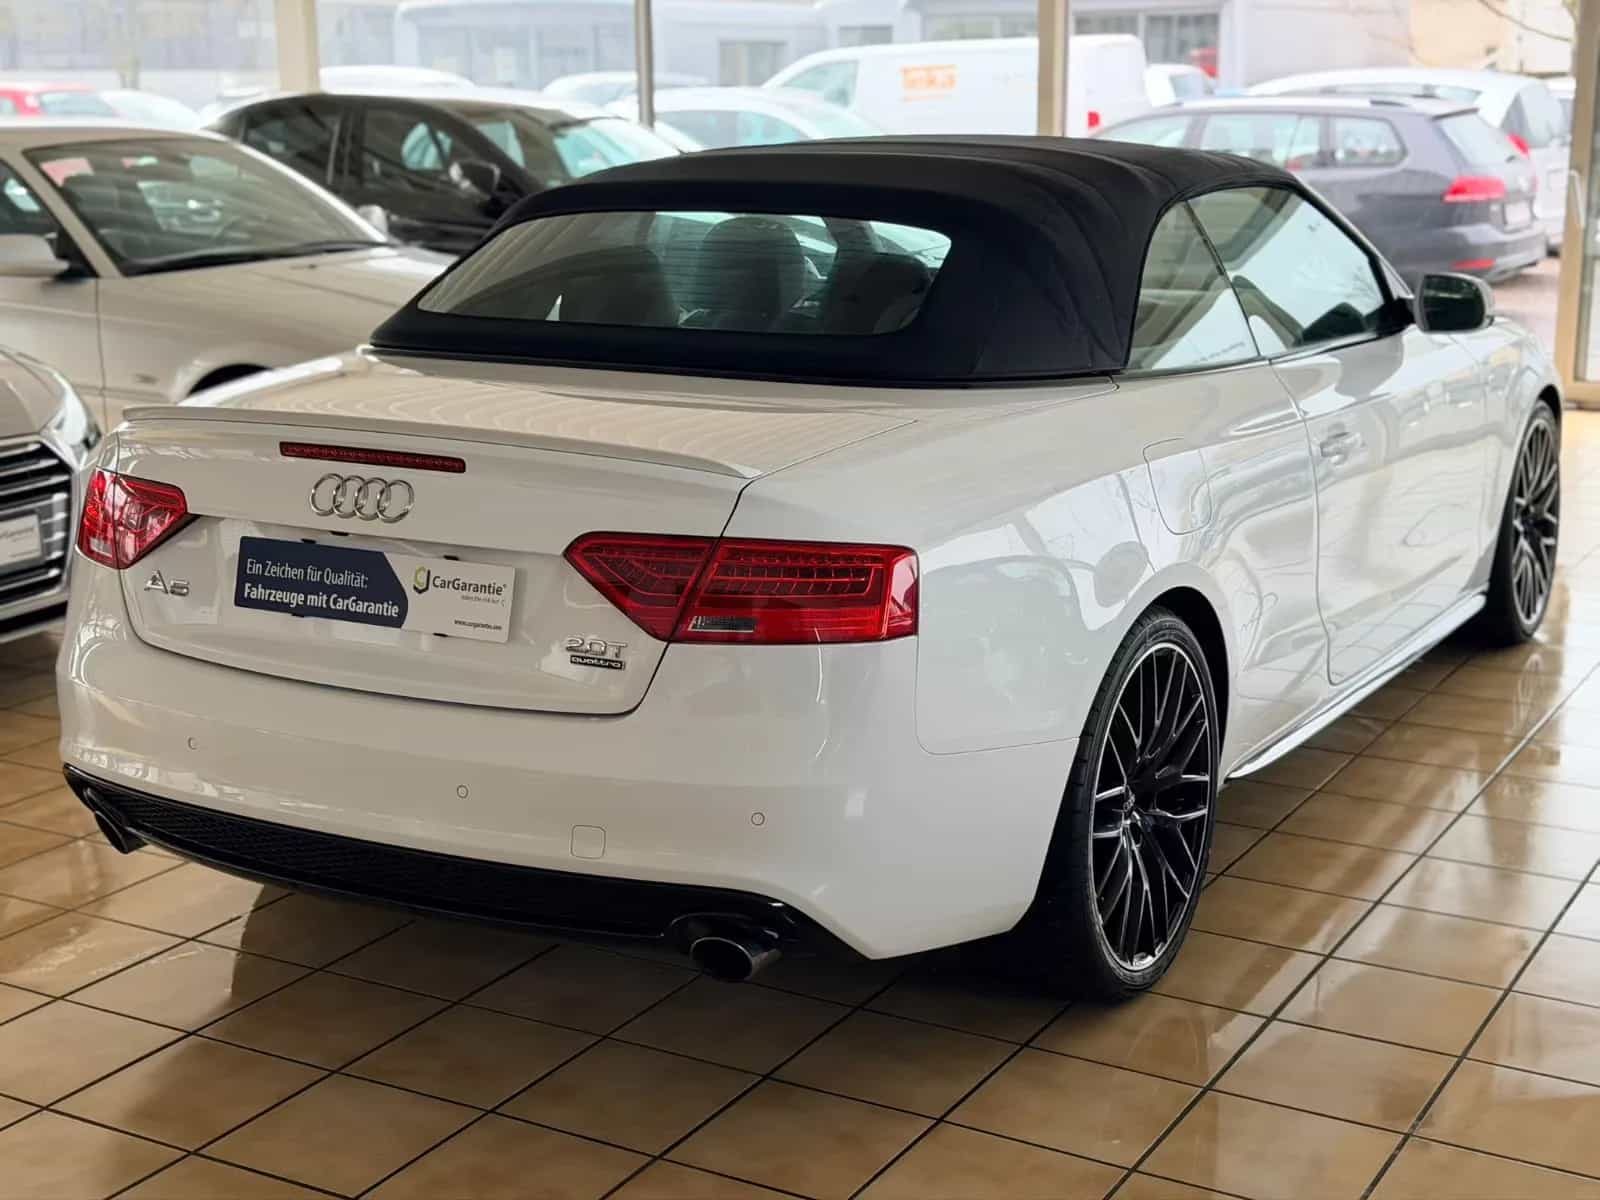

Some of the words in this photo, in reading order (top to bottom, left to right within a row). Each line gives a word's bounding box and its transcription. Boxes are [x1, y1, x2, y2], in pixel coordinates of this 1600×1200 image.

[143, 569, 190, 597] A5
[246, 558, 263, 575] Ein
[264, 560, 305, 581] Zeichen
[306, 564, 323, 583] für
[323, 568, 369, 589] Qualität:
[243, 582, 305, 608] Fahrzeuge
[306, 591, 328, 609] mit
[329, 593, 400, 618] CarGarantie
